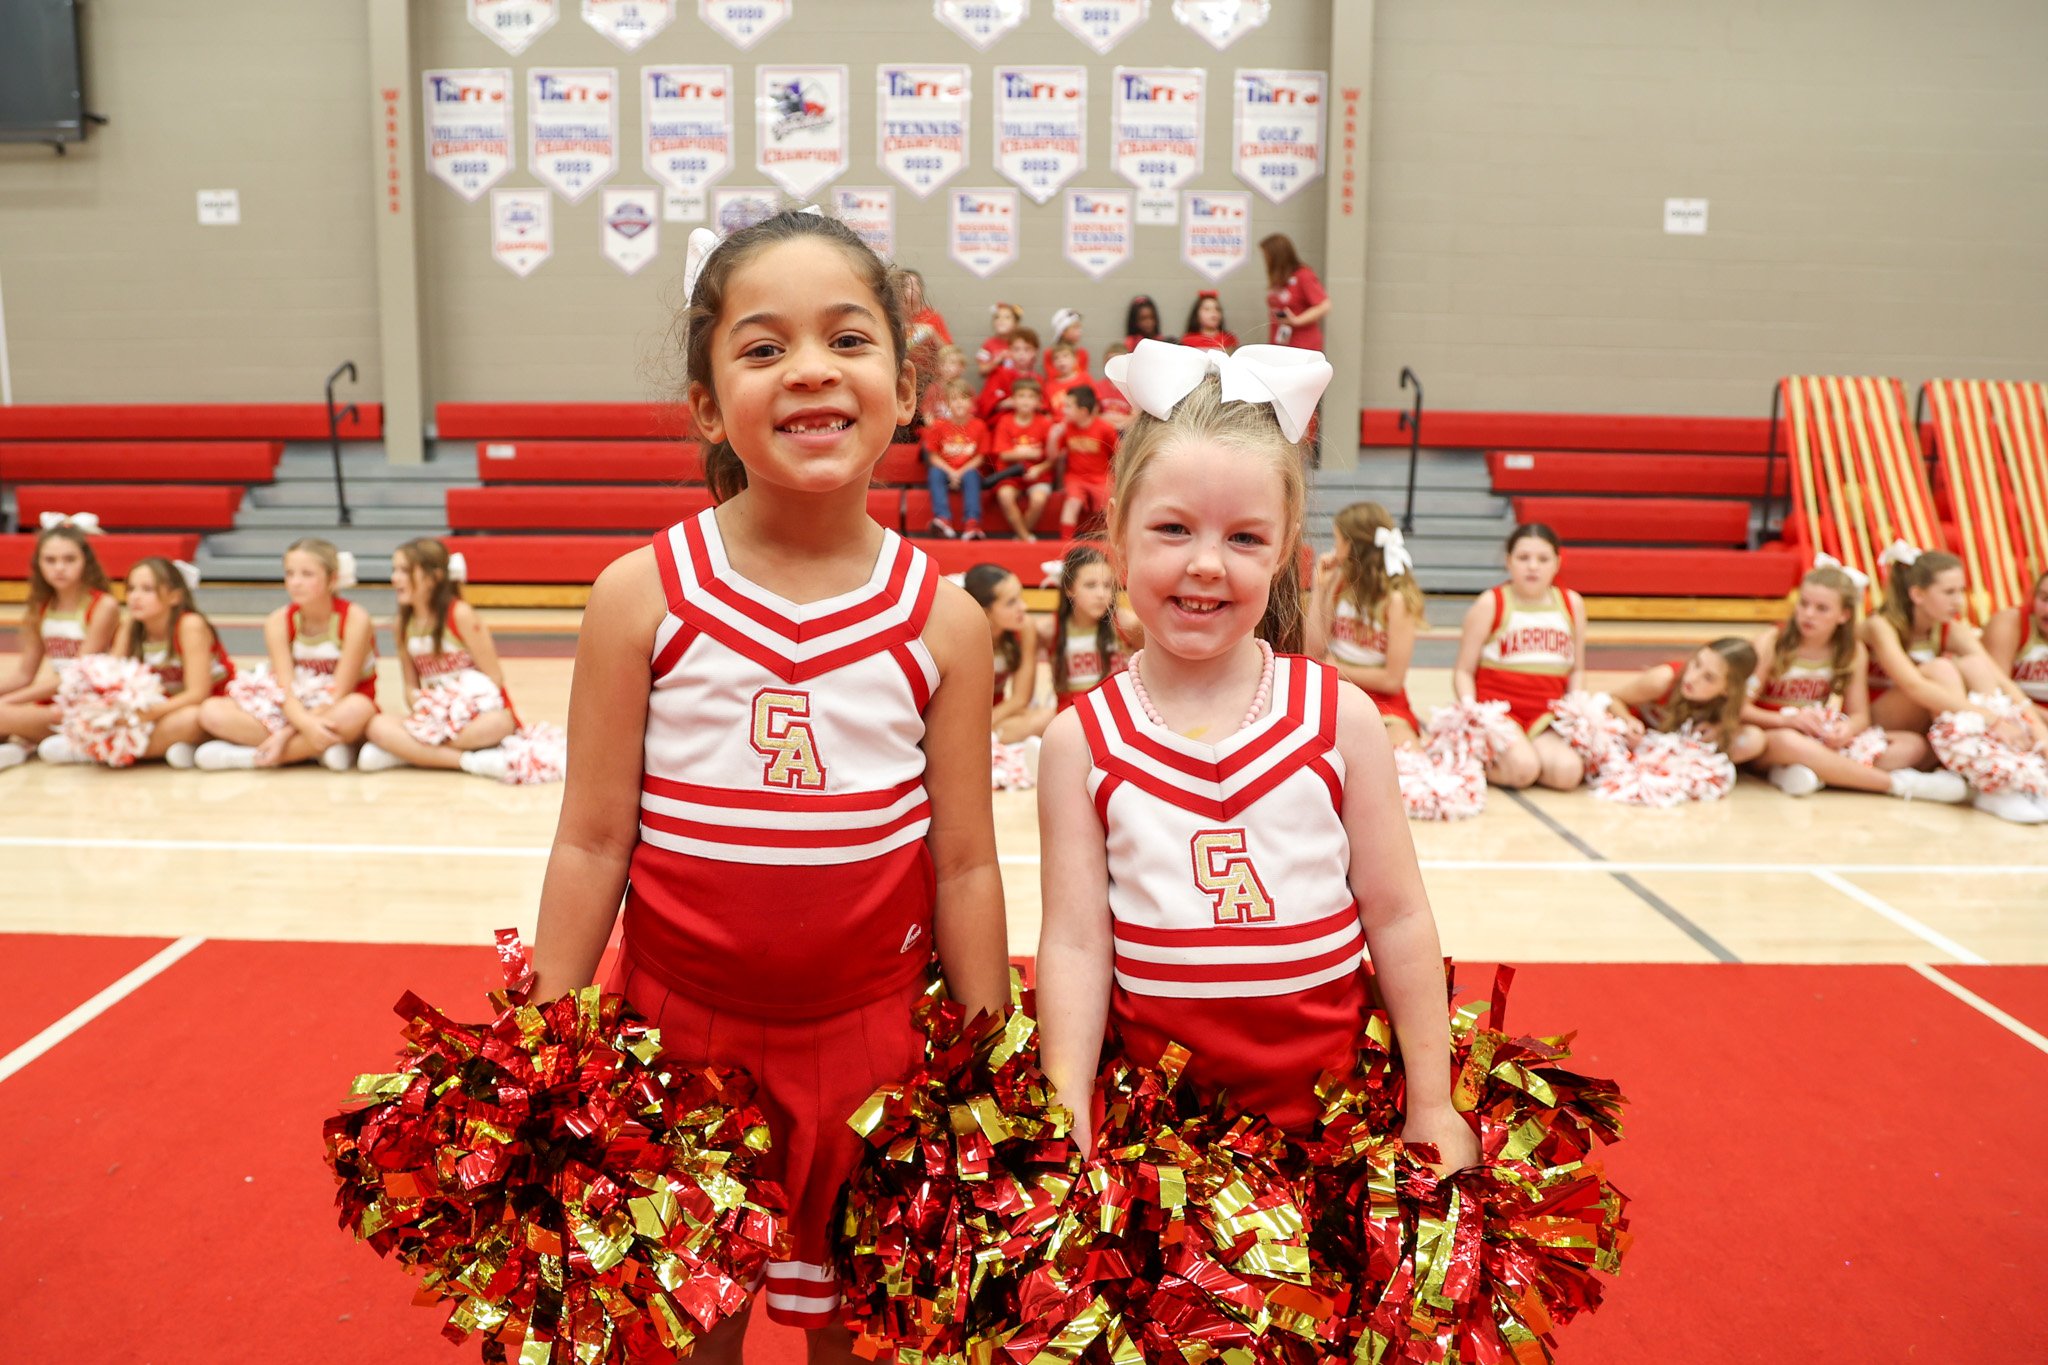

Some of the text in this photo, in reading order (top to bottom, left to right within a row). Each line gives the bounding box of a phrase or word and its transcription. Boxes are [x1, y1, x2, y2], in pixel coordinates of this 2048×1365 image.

[885, 120, 961, 136] TENNIS
[1257, 126, 1303, 142] GOLF
[1342, 88, 1360, 215] WARRIORS
[1499, 627, 1573, 657] WARRIOR
[750, 686, 828, 792] CA
[1190, 827, 1277, 925] CA
